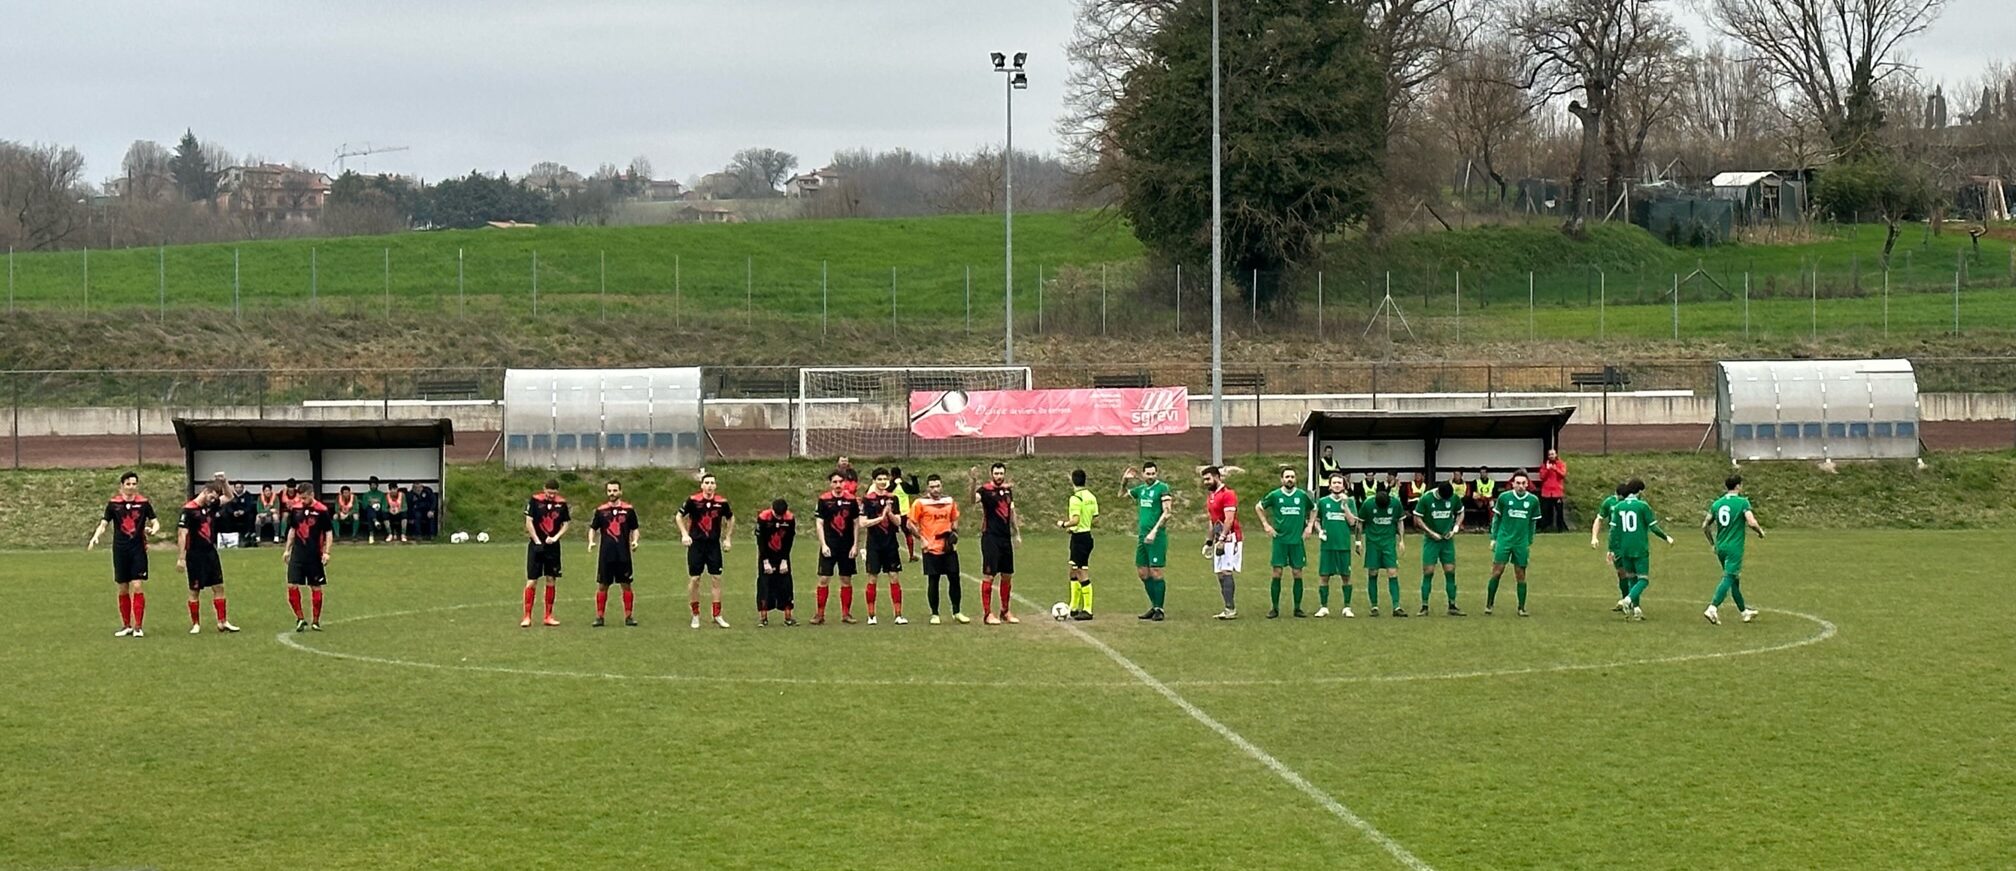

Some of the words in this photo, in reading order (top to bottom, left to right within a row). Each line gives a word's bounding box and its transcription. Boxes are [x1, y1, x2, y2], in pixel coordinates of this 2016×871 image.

[1131, 411, 1178, 426] sgrevi
[1619, 510, 1637, 532] 10
[1718, 505, 1731, 526] 6
